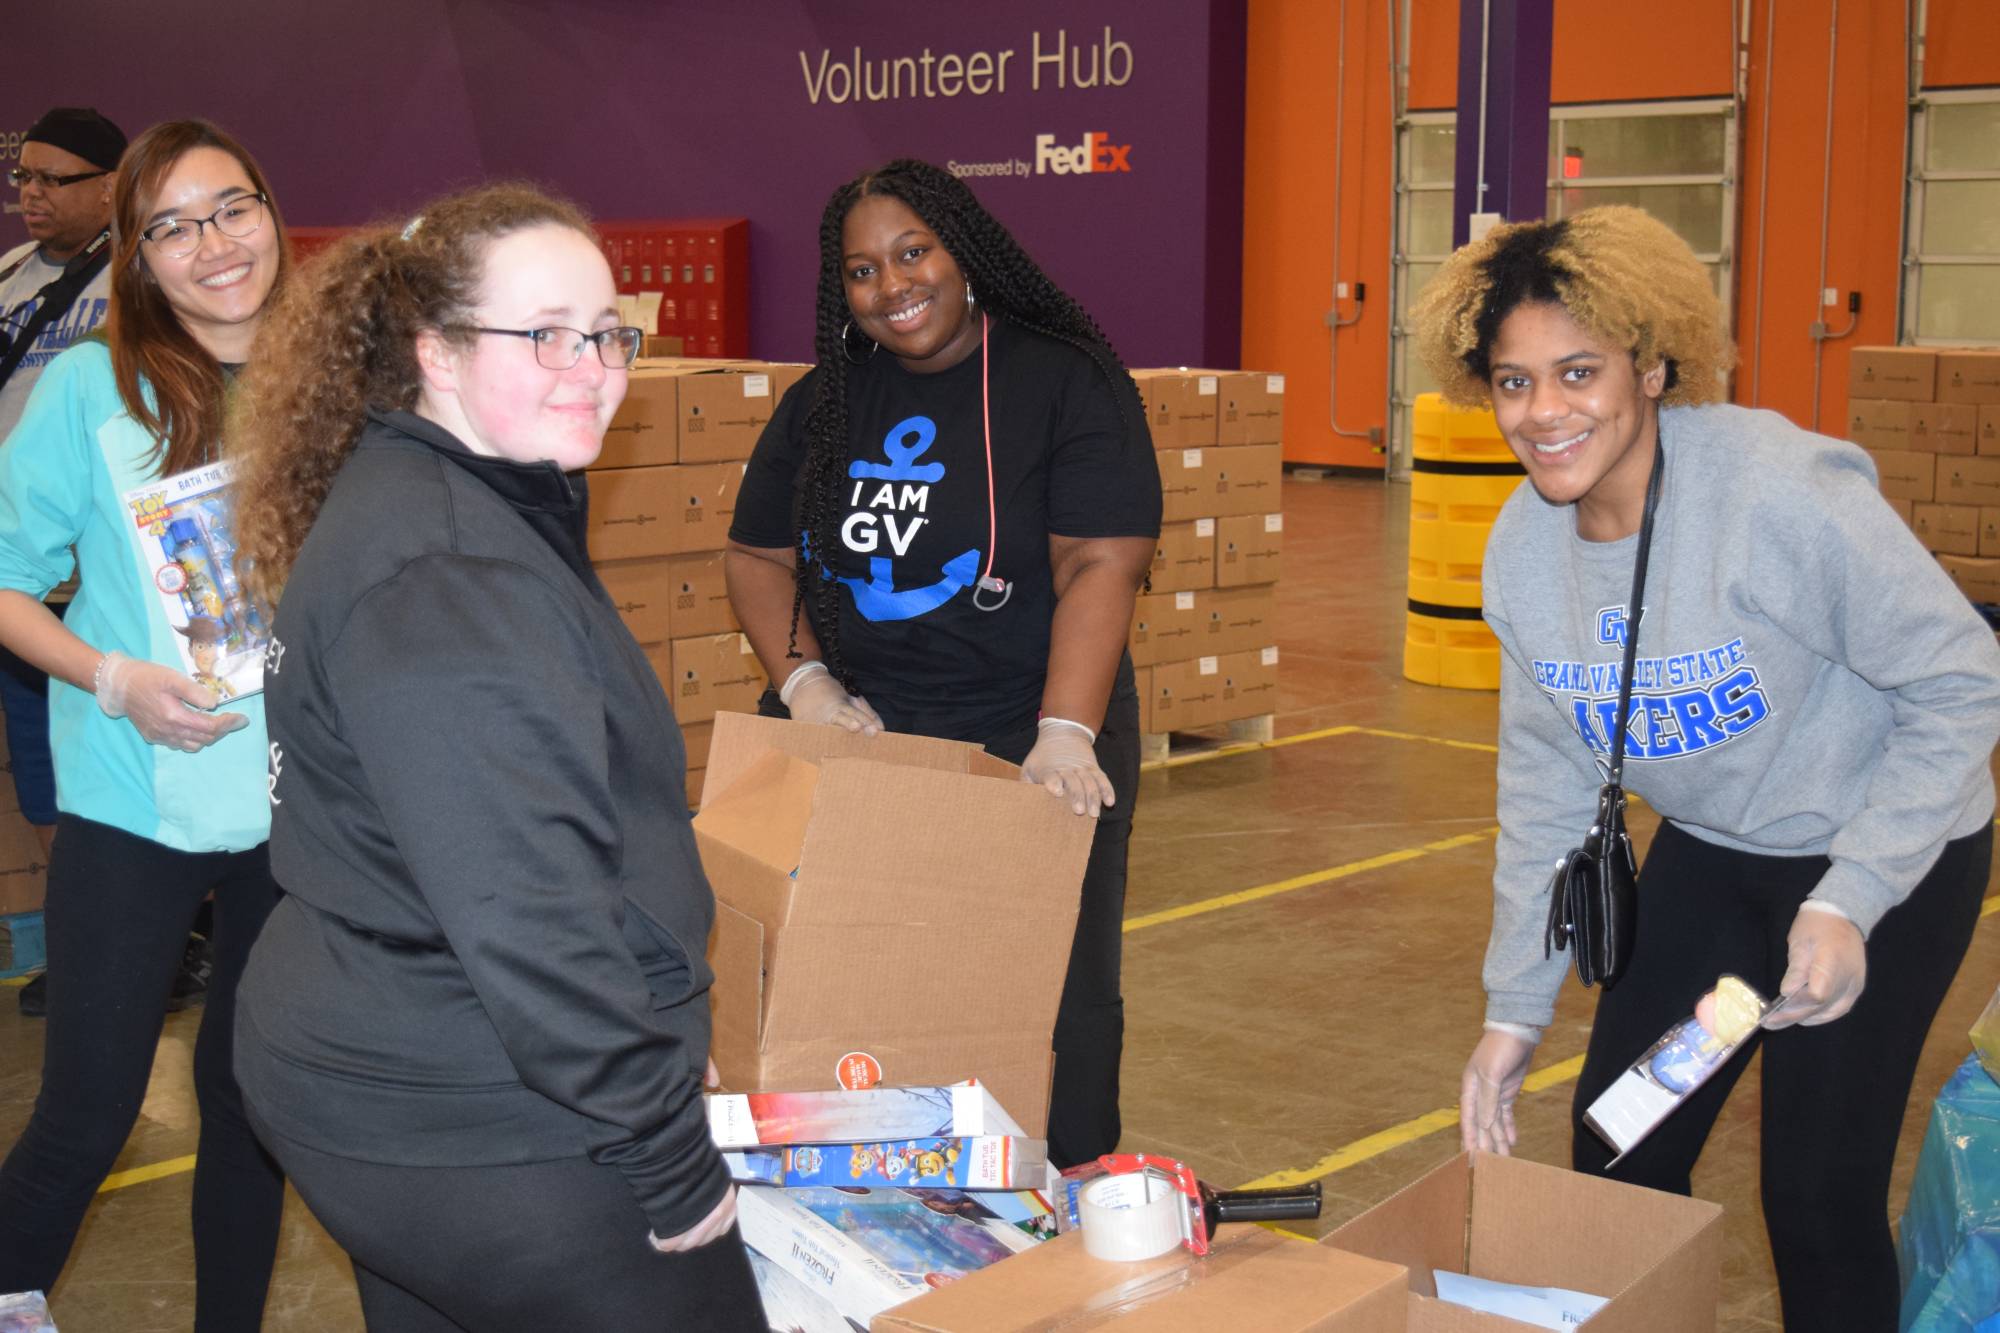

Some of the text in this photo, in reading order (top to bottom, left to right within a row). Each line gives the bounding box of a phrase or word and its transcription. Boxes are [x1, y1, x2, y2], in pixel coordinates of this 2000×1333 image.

[799, 26, 1134, 104] Volunteer Hub
[947, 131, 1132, 178] Sponsored by FedEx
[177, 476, 202, 491] BATH
[204, 468, 221, 482] TUB
[851, 481, 930, 512] I AM
[128, 490, 168, 516] TOY
[149, 520, 166, 536] 4
[841, 511, 926, 556] GV
[1588, 658, 1663, 695] VALEY
[1666, 636, 1746, 686] STATE
[1545, 665, 1771, 761] AKERS
[800, 1250, 836, 1285] FROZEN
